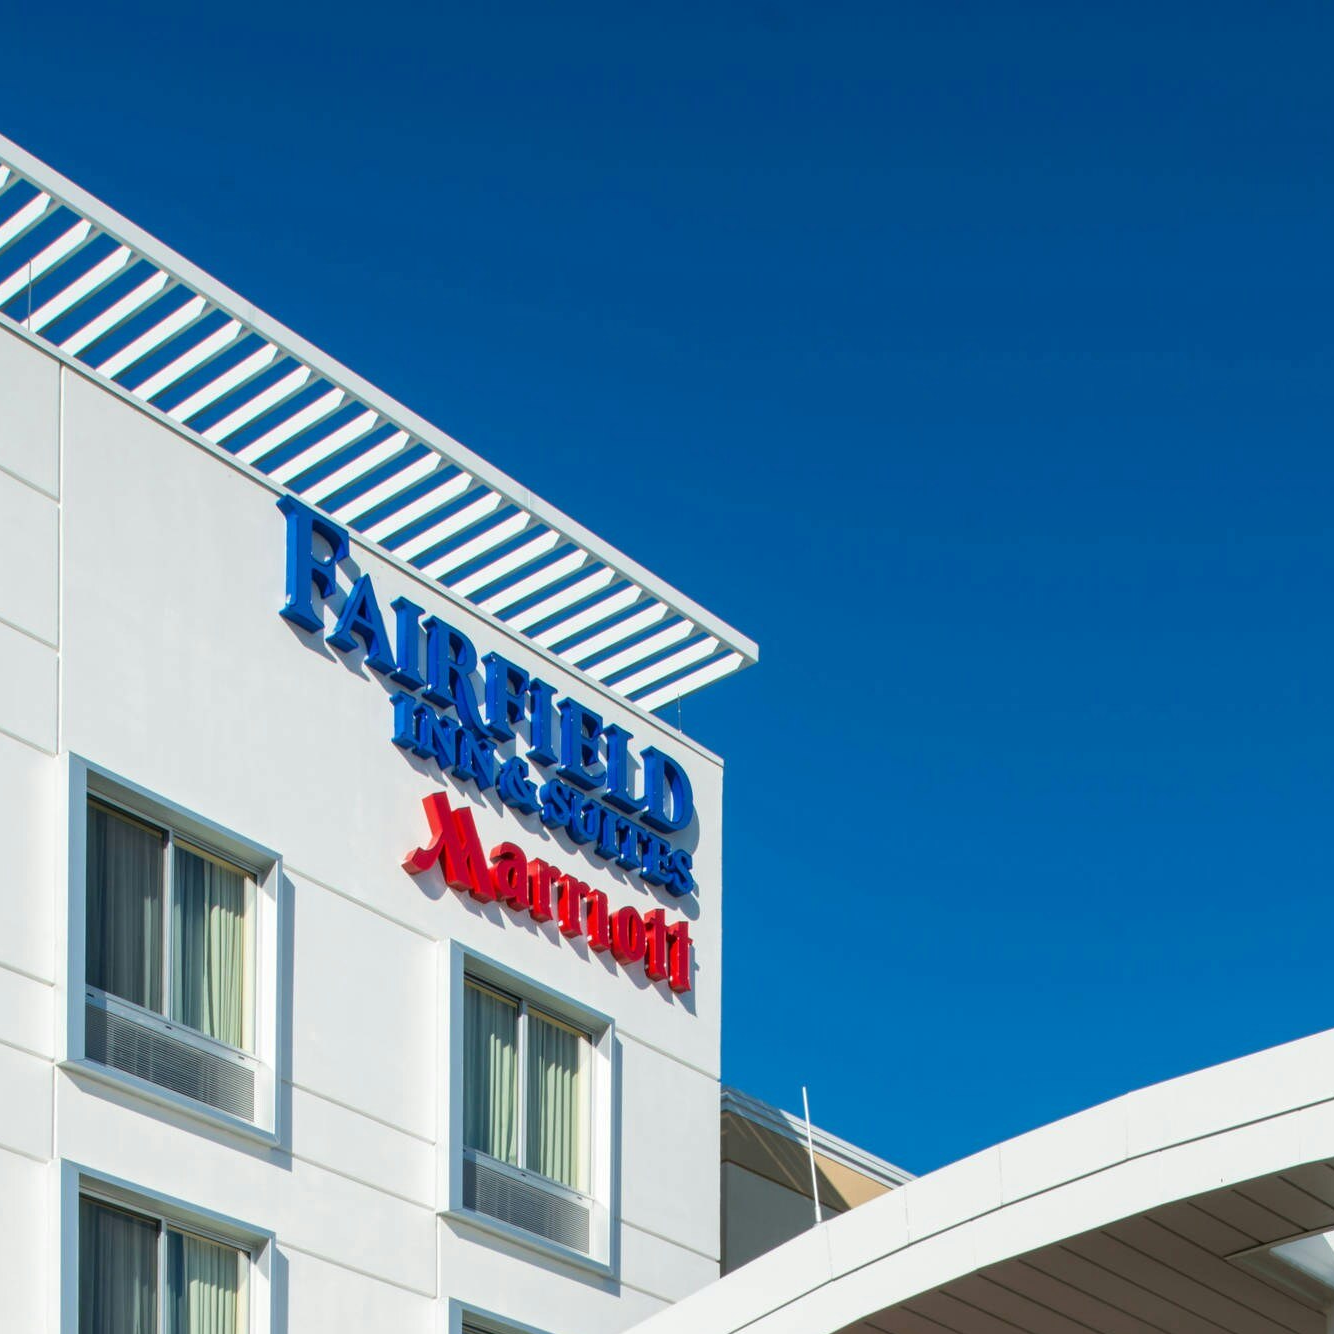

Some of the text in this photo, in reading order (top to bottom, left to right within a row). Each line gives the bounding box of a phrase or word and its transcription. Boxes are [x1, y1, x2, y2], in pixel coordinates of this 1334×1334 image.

[276, 494, 694, 835] FAIRFIELD
[391, 691, 694, 897] INN & SUITES
[402, 792, 693, 994] Marriott
